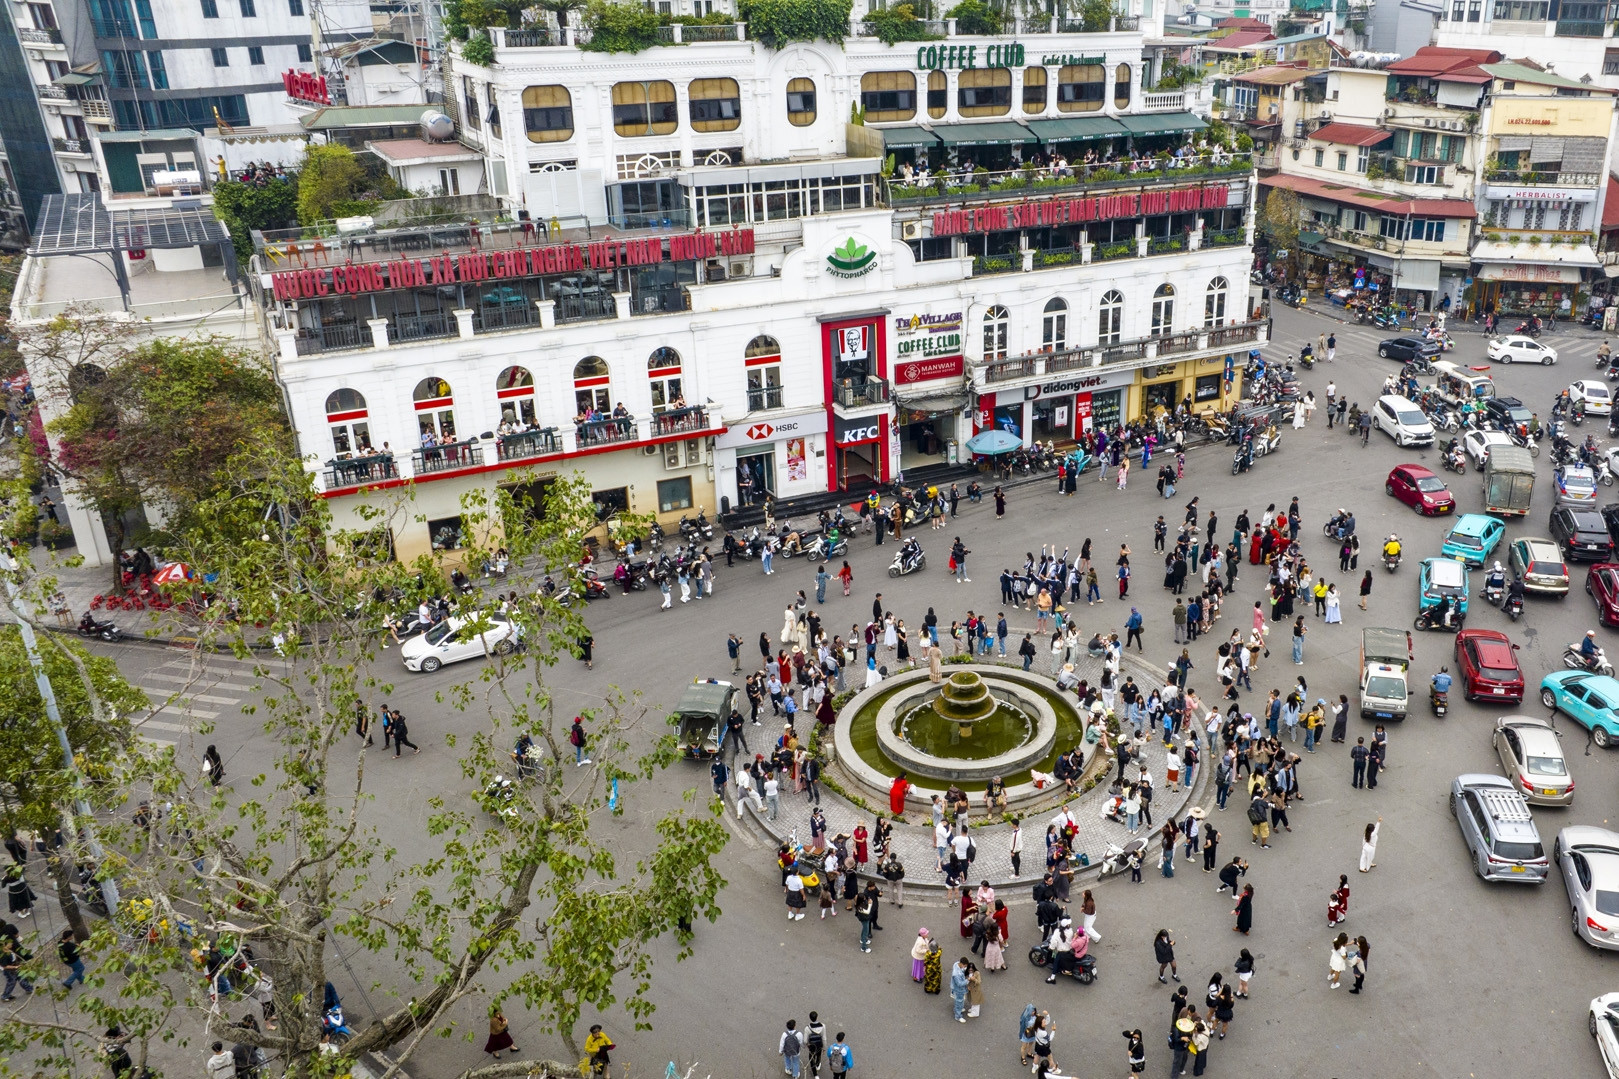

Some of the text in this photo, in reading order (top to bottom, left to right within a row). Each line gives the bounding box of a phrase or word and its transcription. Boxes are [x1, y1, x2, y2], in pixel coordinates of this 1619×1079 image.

[917, 43, 1025, 70] COFFEE CLUB
[974, 201, 1008, 235] CỘNG
[1013, 194, 1038, 228] SẢN
[1041, 195, 1066, 228] VIỆT
[1069, 198, 1096, 222] NAM
[1098, 194, 1137, 221] QUANG
[1141, 192, 1166, 215] VINH
[1169, 184, 1201, 212] MUÔN
[1202, 182, 1228, 209] NĂM
[332, 258, 384, 299] CỘNG
[388, 252, 427, 289] HÒA
[430, 250, 456, 285] XÃ
[458, 246, 489, 286] HỘI
[492, 240, 528, 278] CHỦ
[531, 239, 584, 275] NGHĨA
[588, 235, 622, 273] VIỆT
[626, 237, 662, 266] NAM
[669, 227, 716, 262] MUÔN
[720, 223, 755, 256] NĂM
[826, 261, 878, 279] PHYTOPHARCO
[898, 334, 960, 354] COFFEE CLUB
[921, 362, 956, 372] MANWAH
[775, 422, 798, 432] HSBC
[842, 426, 878, 443] KFC
